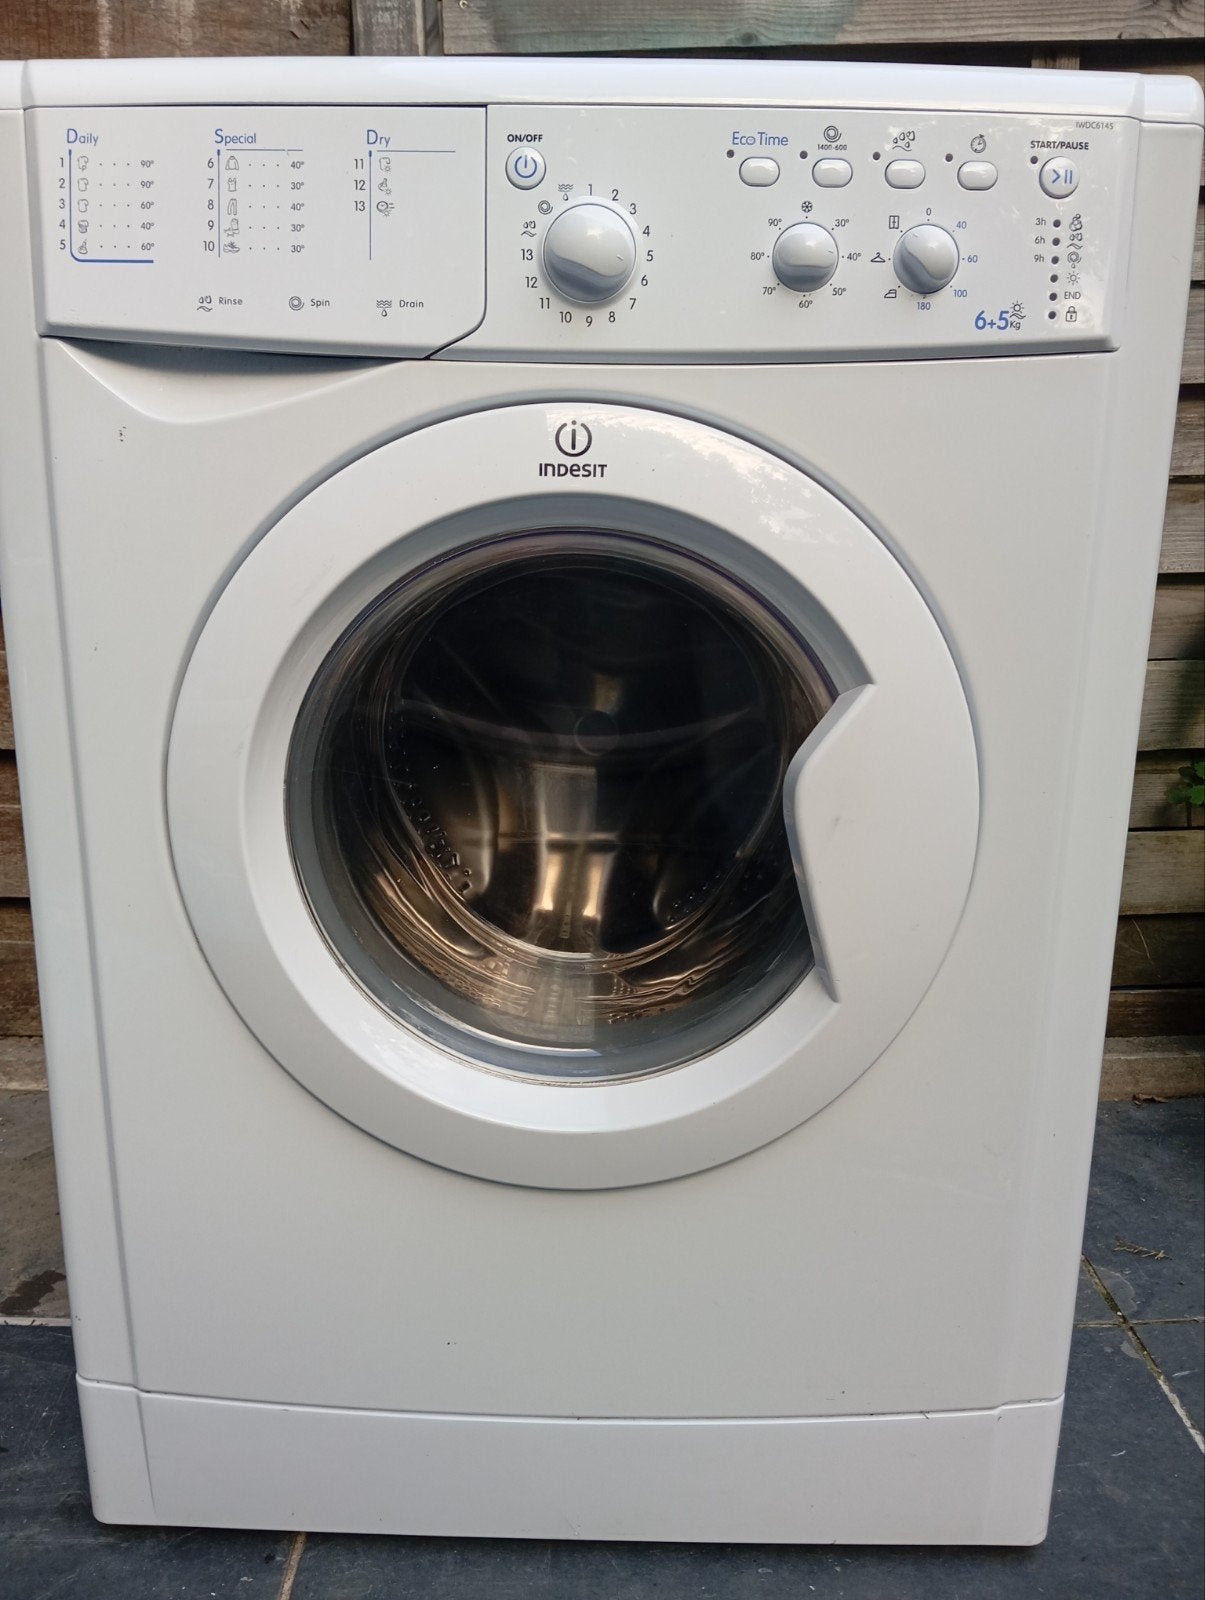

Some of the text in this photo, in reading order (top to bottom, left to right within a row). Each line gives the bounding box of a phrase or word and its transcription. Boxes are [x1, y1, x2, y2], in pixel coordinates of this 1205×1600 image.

[66, 128, 99, 146] Daily
[214, 128, 257, 146] Special
[366, 129, 391, 148] Dry
[507, 133, 543, 143] ON/OFF
[1030, 140, 1089, 150] START/PAUSE
[59, 158, 65, 167] 1
[207, 159, 214, 168] 6
[354, 159, 365, 169] 11
[58, 178, 66, 188] 2
[207, 179, 214, 189] 7
[354, 180, 366, 190] 12
[587, 183, 593, 196] 1
[611, 189, 619, 201] 2
[58, 199, 66, 209] 3
[207, 200, 214, 210] 8
[354, 201, 366, 211] 13
[628, 203, 637, 215] 3
[925, 207, 932, 216] 0
[58, 219, 66, 229] 4
[207, 220, 214, 231] 9
[956, 220, 967, 230] 40
[1035, 217, 1046, 226] 3h
[642, 225, 651, 237] 4
[1034, 235, 1045, 244] 6h
[59, 240, 66, 250] 5
[202, 241, 215, 251] 10
[521, 248, 534, 261] 13
[646, 250, 654, 262] 5
[967, 254, 978, 264] 60
[1034, 254, 1045, 263] 9h
[525, 276, 538, 289] 12
[640, 275, 648, 287] 6
[953, 289, 968, 298] 100
[1064, 291, 1081, 300] END
[218, 297, 243, 306] Rinse
[310, 298, 330, 309] Spin
[398, 299, 424, 308] Drain
[539, 297, 551, 309] 11
[629, 297, 636, 310] 7
[916, 301, 931, 311] 180
[559, 311, 572, 324] 10
[585, 316, 593, 328] 9
[607, 311, 616, 323] 8
